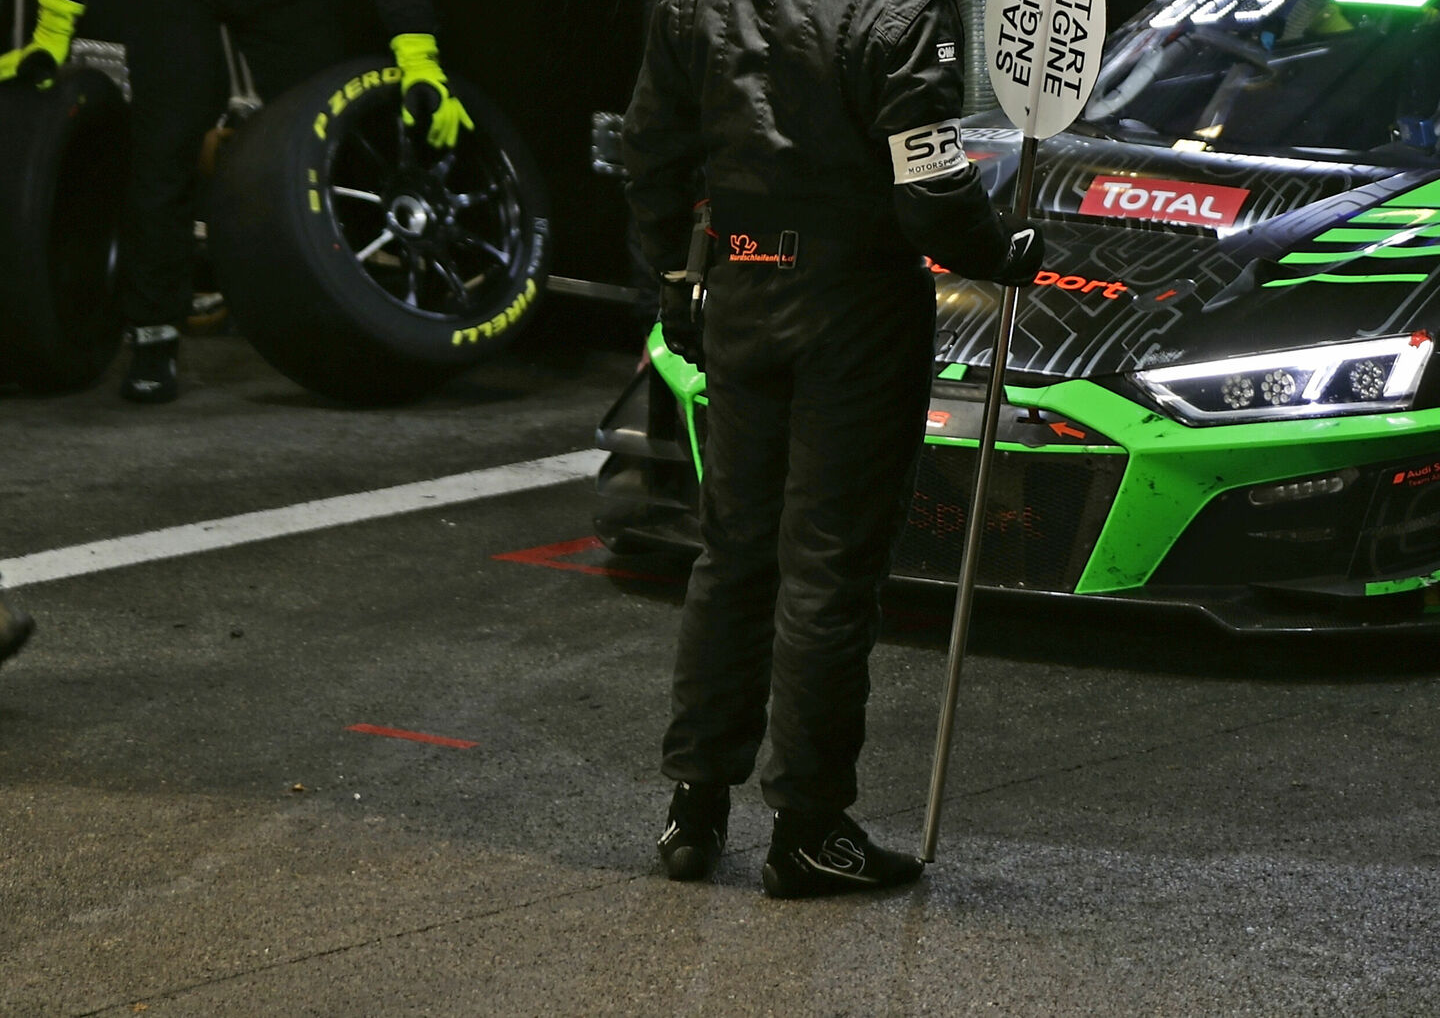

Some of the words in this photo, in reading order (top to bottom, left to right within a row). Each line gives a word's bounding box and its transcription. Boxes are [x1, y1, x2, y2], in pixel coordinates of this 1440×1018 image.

[328, 66, 403, 117] ZERO
[1103, 181, 1224, 220] TOTAL
[451, 277, 537, 346] PIRELLI
[1406, 466, 1432, 479] Audi
